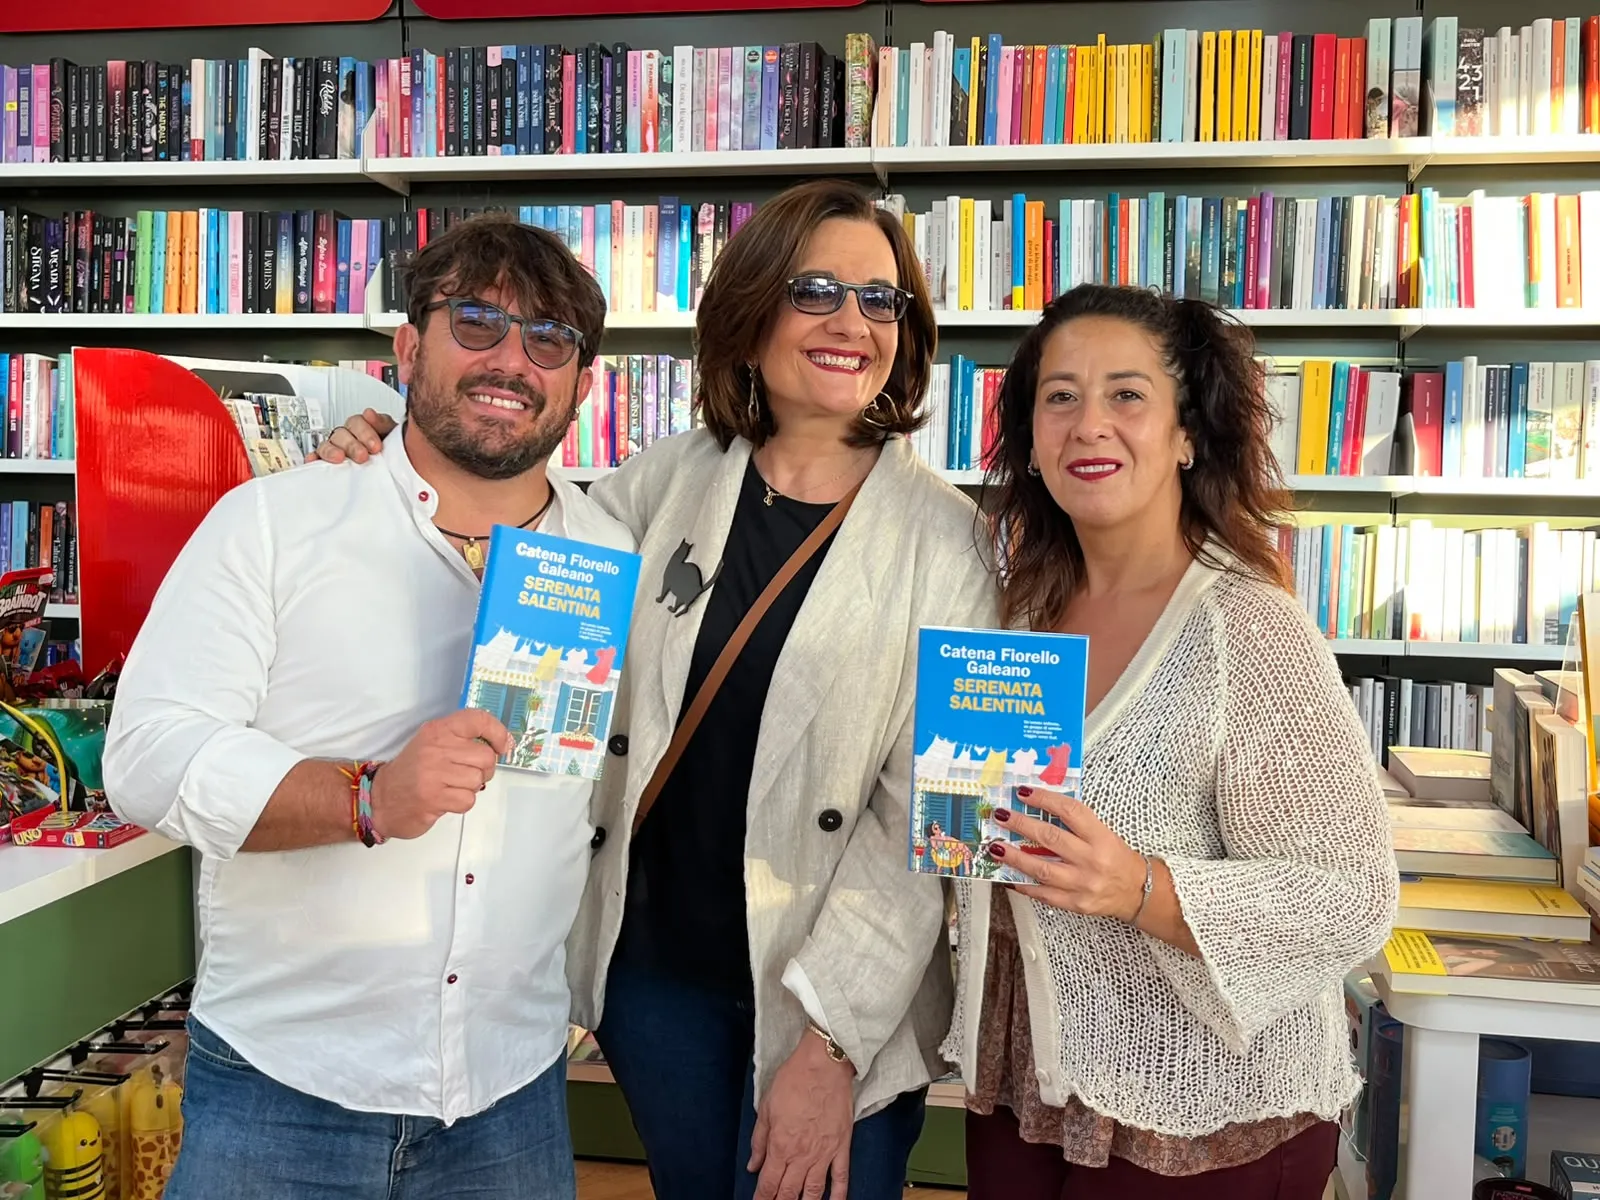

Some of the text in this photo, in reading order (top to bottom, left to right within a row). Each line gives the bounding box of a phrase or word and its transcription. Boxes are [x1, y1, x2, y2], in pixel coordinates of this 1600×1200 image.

[158, 96, 166, 144] THE NATURALS
[30, 246, 42, 289] STIGMA
[49, 246, 59, 290] ARCADIA
[264, 250, 274, 289] HEARTLESS
[516, 542, 620, 575] Catena Fiorello
[538, 561, 594, 583] Galeano
[524, 576, 601, 603] SERENATA
[518, 591, 600, 620] SALENTINA
[940, 644, 1060, 665] Catena Fiorello
[967, 661, 1031, 677] Galeano
[954, 678, 1042, 698] SERENATA
[950, 695, 1045, 715] SALENTINA
[14, 828, 42, 845] UNO
[1563, 1156, 1599, 1168] QU
